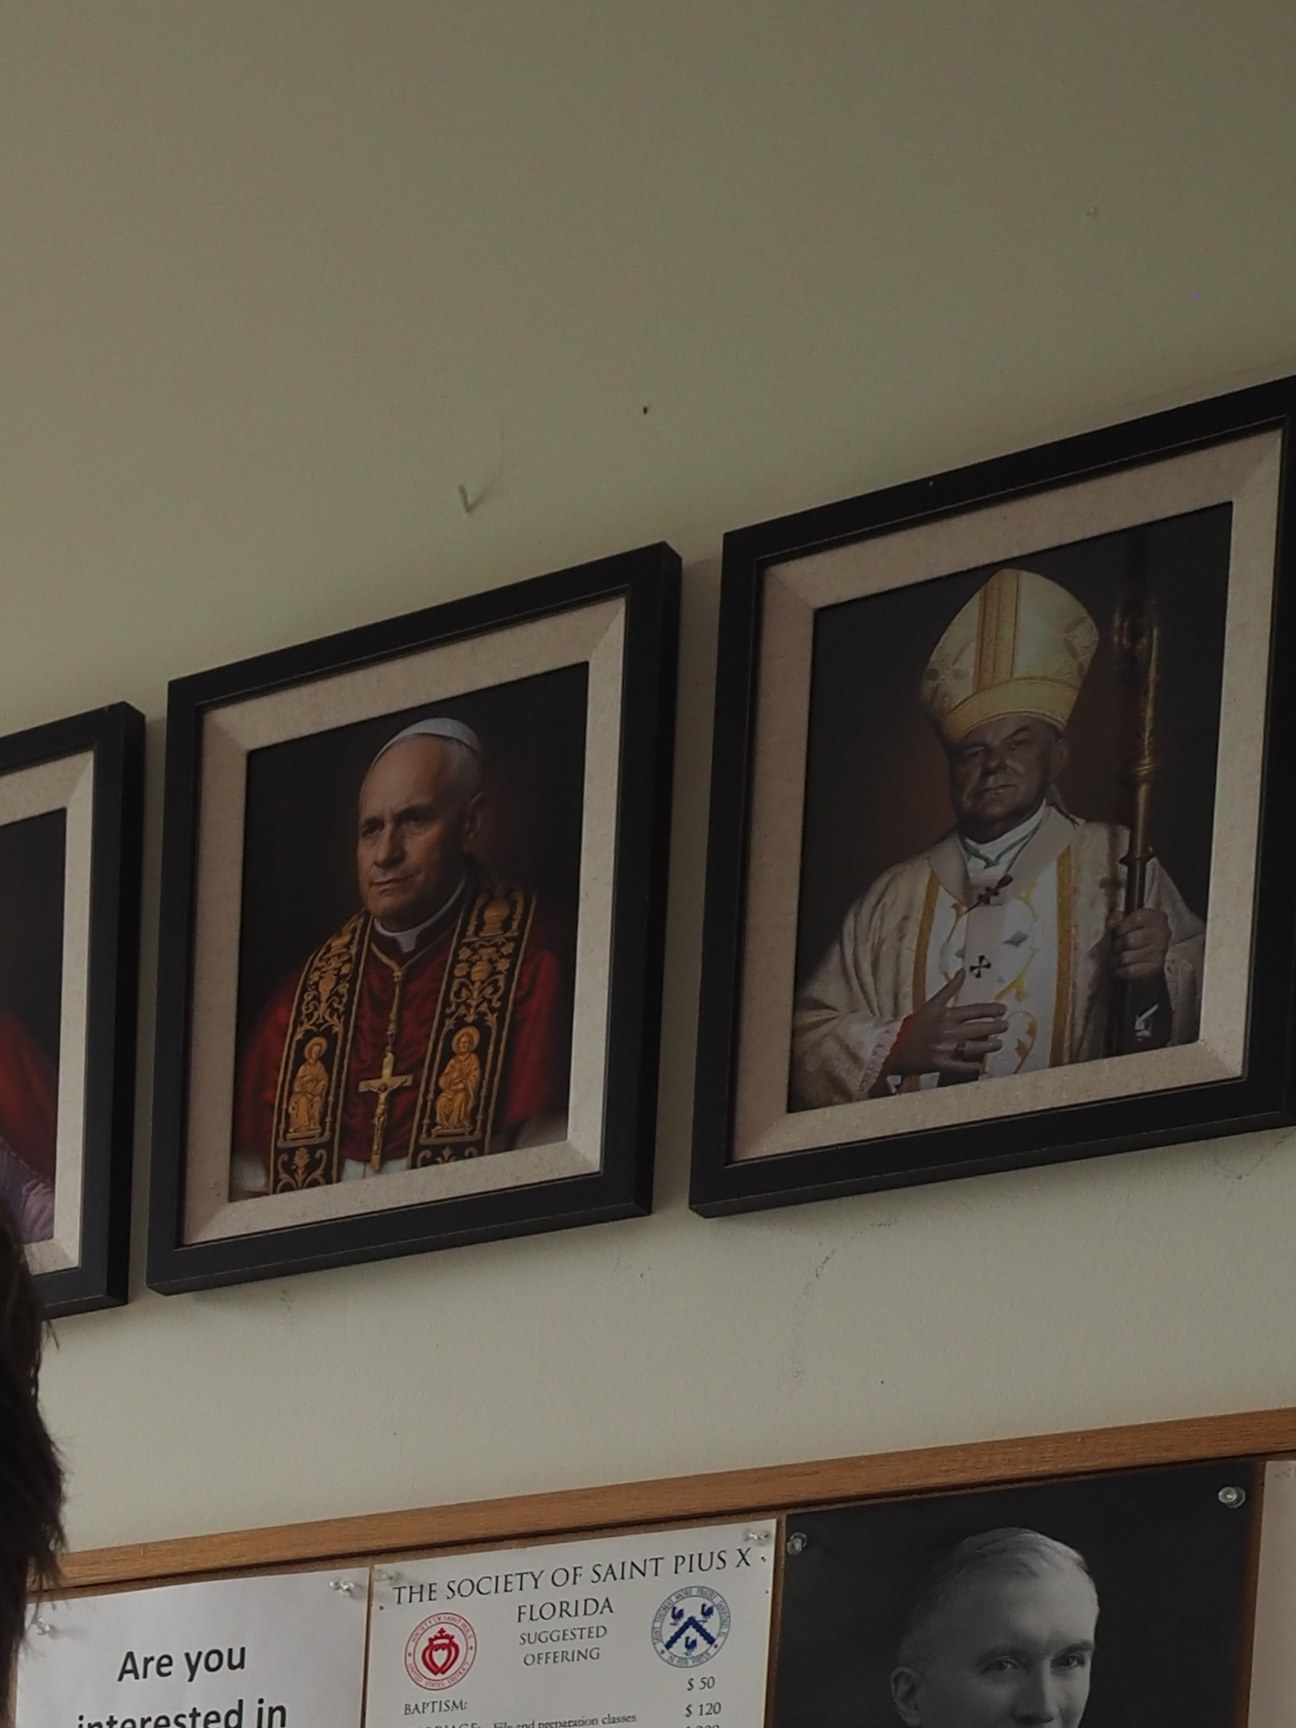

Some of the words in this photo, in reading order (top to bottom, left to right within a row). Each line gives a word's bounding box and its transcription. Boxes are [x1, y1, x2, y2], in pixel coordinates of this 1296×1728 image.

[393, 1582, 436, 1605] THE
[447, 1570, 544, 1600] SOCIETY
[551, 1566, 582, 1588] OF
[591, 1556, 664, 1584] SAINT
[674, 1549, 726, 1575] PIUS
[736, 1547, 750, 1568] X
[518, 1597, 613, 1623] FLORIDA
[520, 1625, 607, 1645] SUGGESTED
[118, 1651, 173, 1682] Are
[185, 1646, 245, 1683] you
[524, 1646, 599, 1666] OFFERING
[405, 1699, 467, 1716] BAPTISM:
